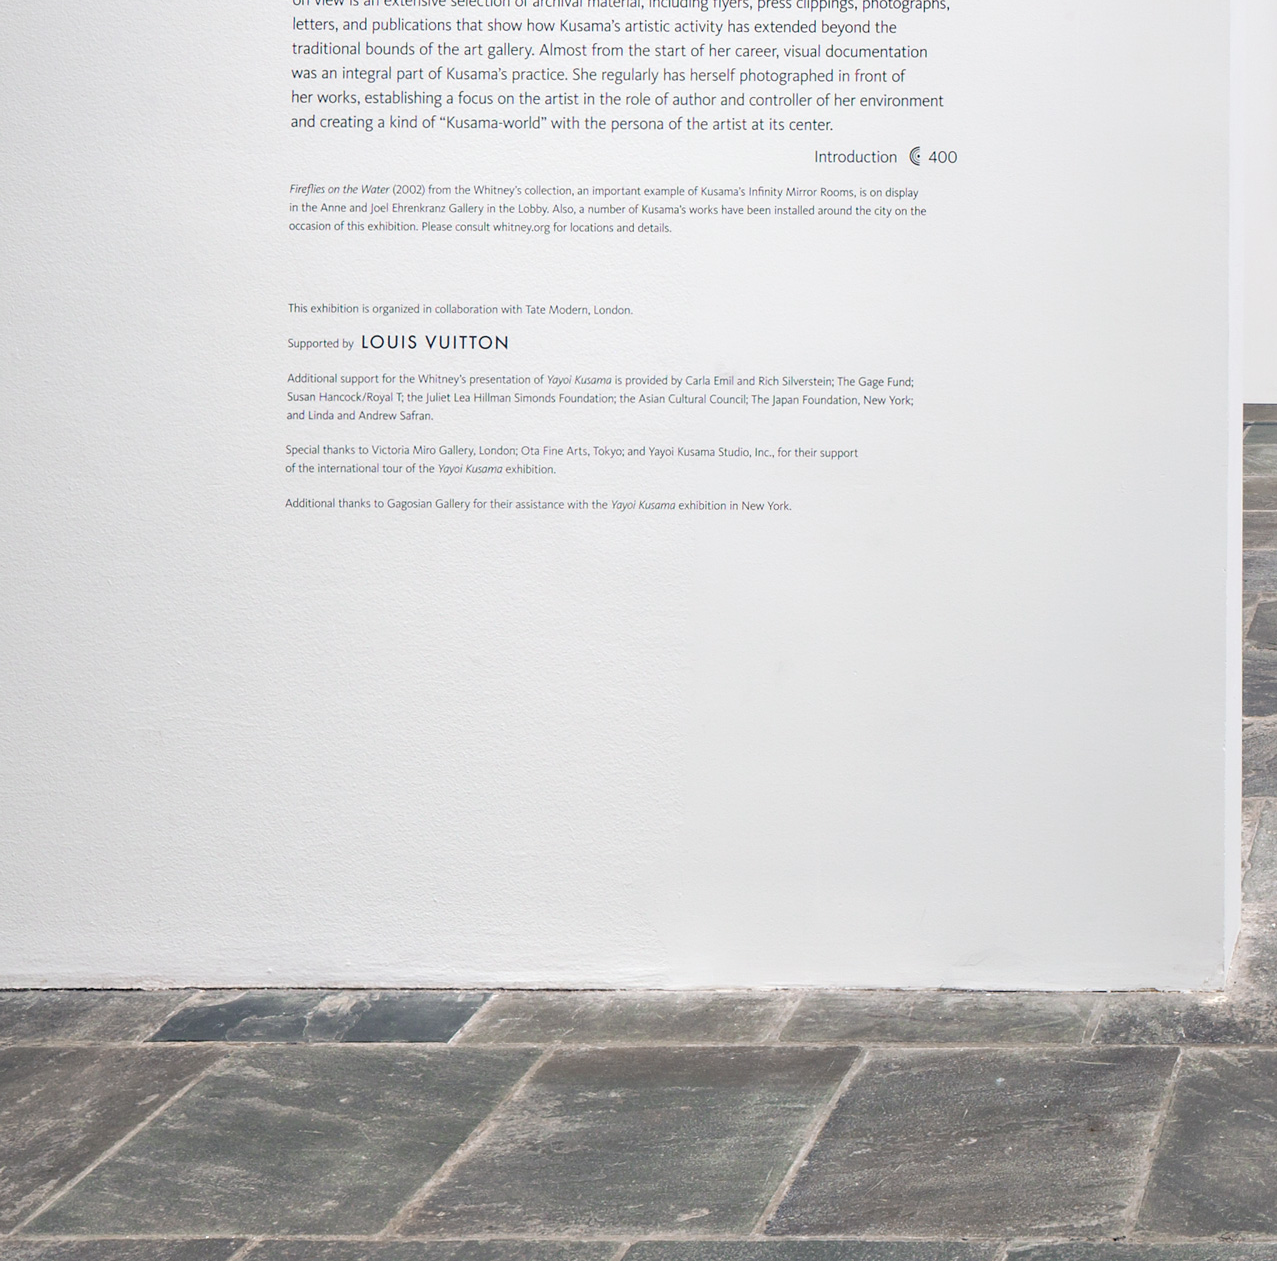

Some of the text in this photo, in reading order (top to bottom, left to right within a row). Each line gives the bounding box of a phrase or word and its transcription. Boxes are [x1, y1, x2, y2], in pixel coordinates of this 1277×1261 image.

[292, 16, 897, 37] letters, and publications that show how Kusama’s artistic activity has extended beyond the
[814, 148, 958, 164] Introduction 400
[288, 219, 672, 235] occasion of this exhibition. Please consult whitney.org for locations and details.
[287, 334, 510, 351] Supported by LOUIS VUITTON
[286, 409, 434, 421] and Linda and Andrew Safran.
[284, 497, 792, 513] Additional thanks to Gagosian Gallery for their assistance with the Yayoi Kusama exhibition in New York.
